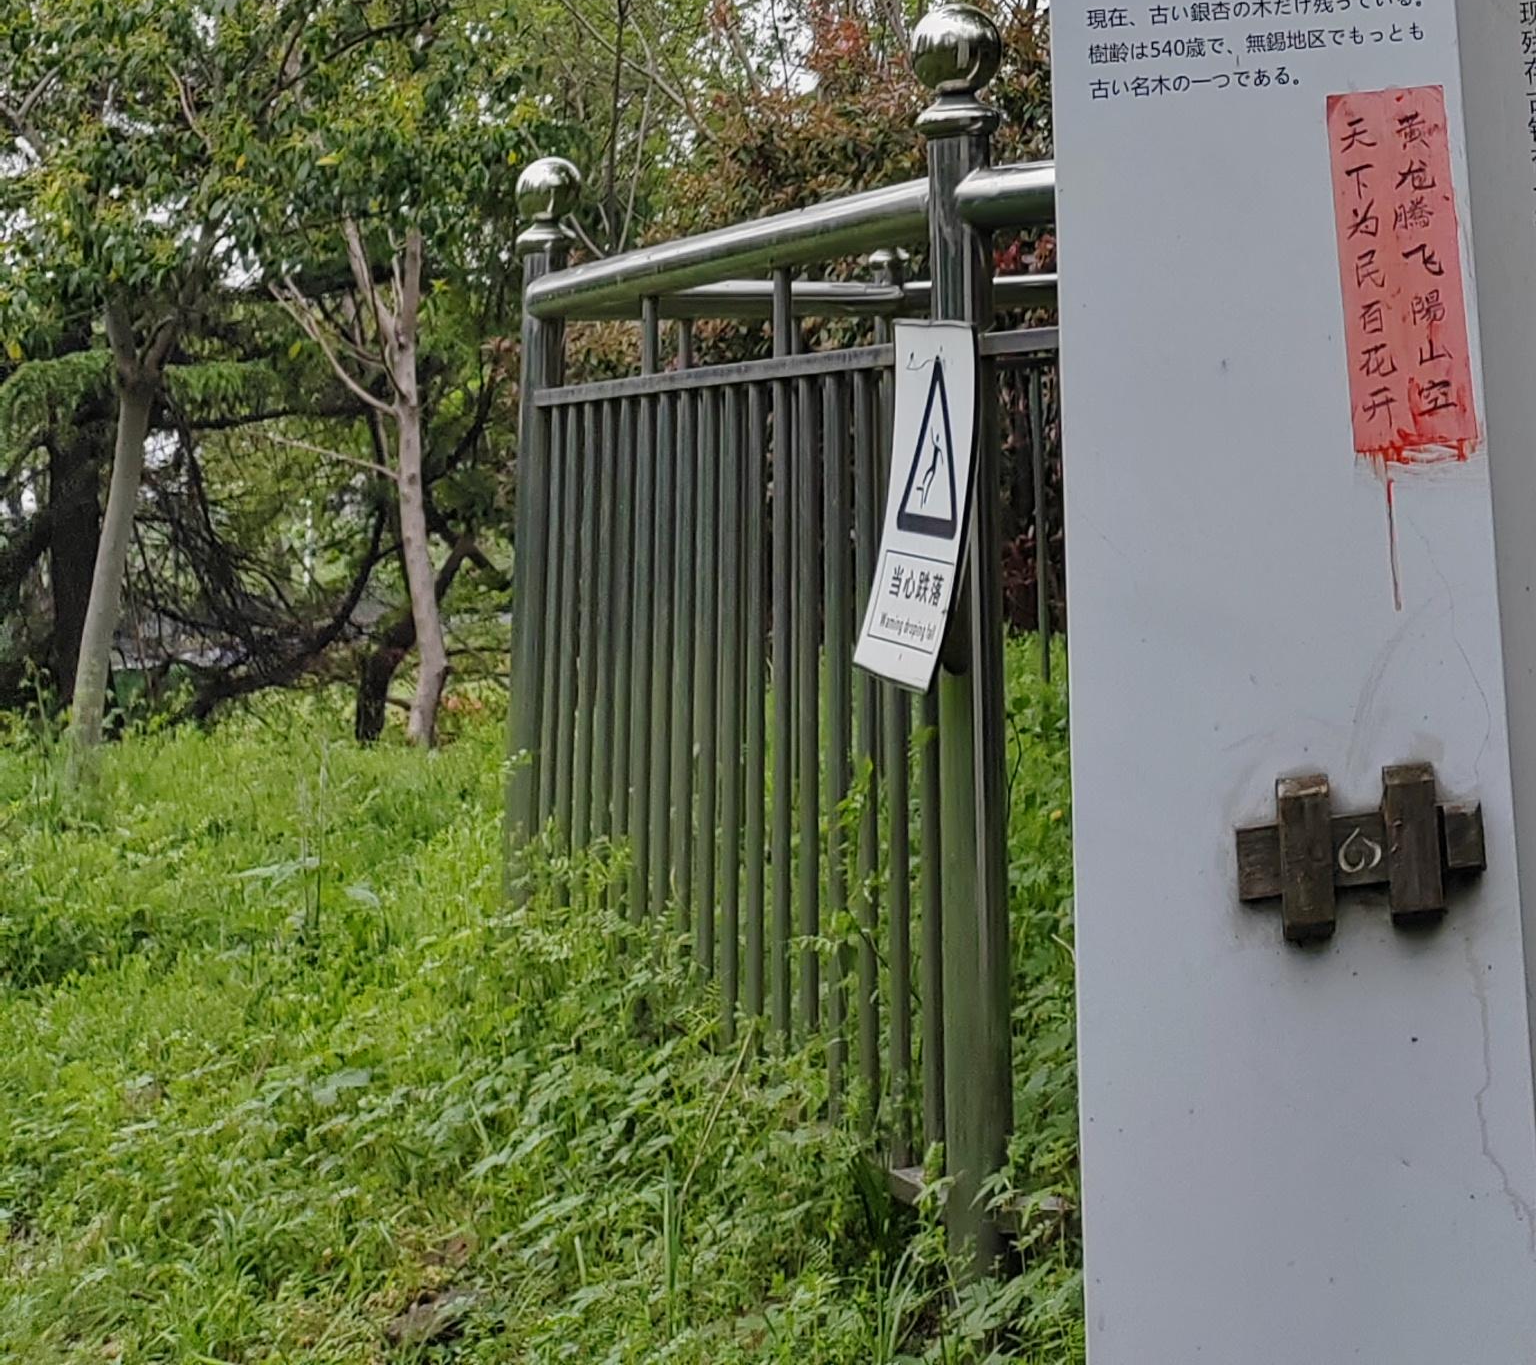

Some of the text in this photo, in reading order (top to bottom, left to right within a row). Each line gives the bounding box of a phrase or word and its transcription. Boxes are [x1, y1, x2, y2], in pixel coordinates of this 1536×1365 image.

[1089, 66, 1300, 100] 古い名木の一つである。
[889, 565, 944, 607] 当心跌落
